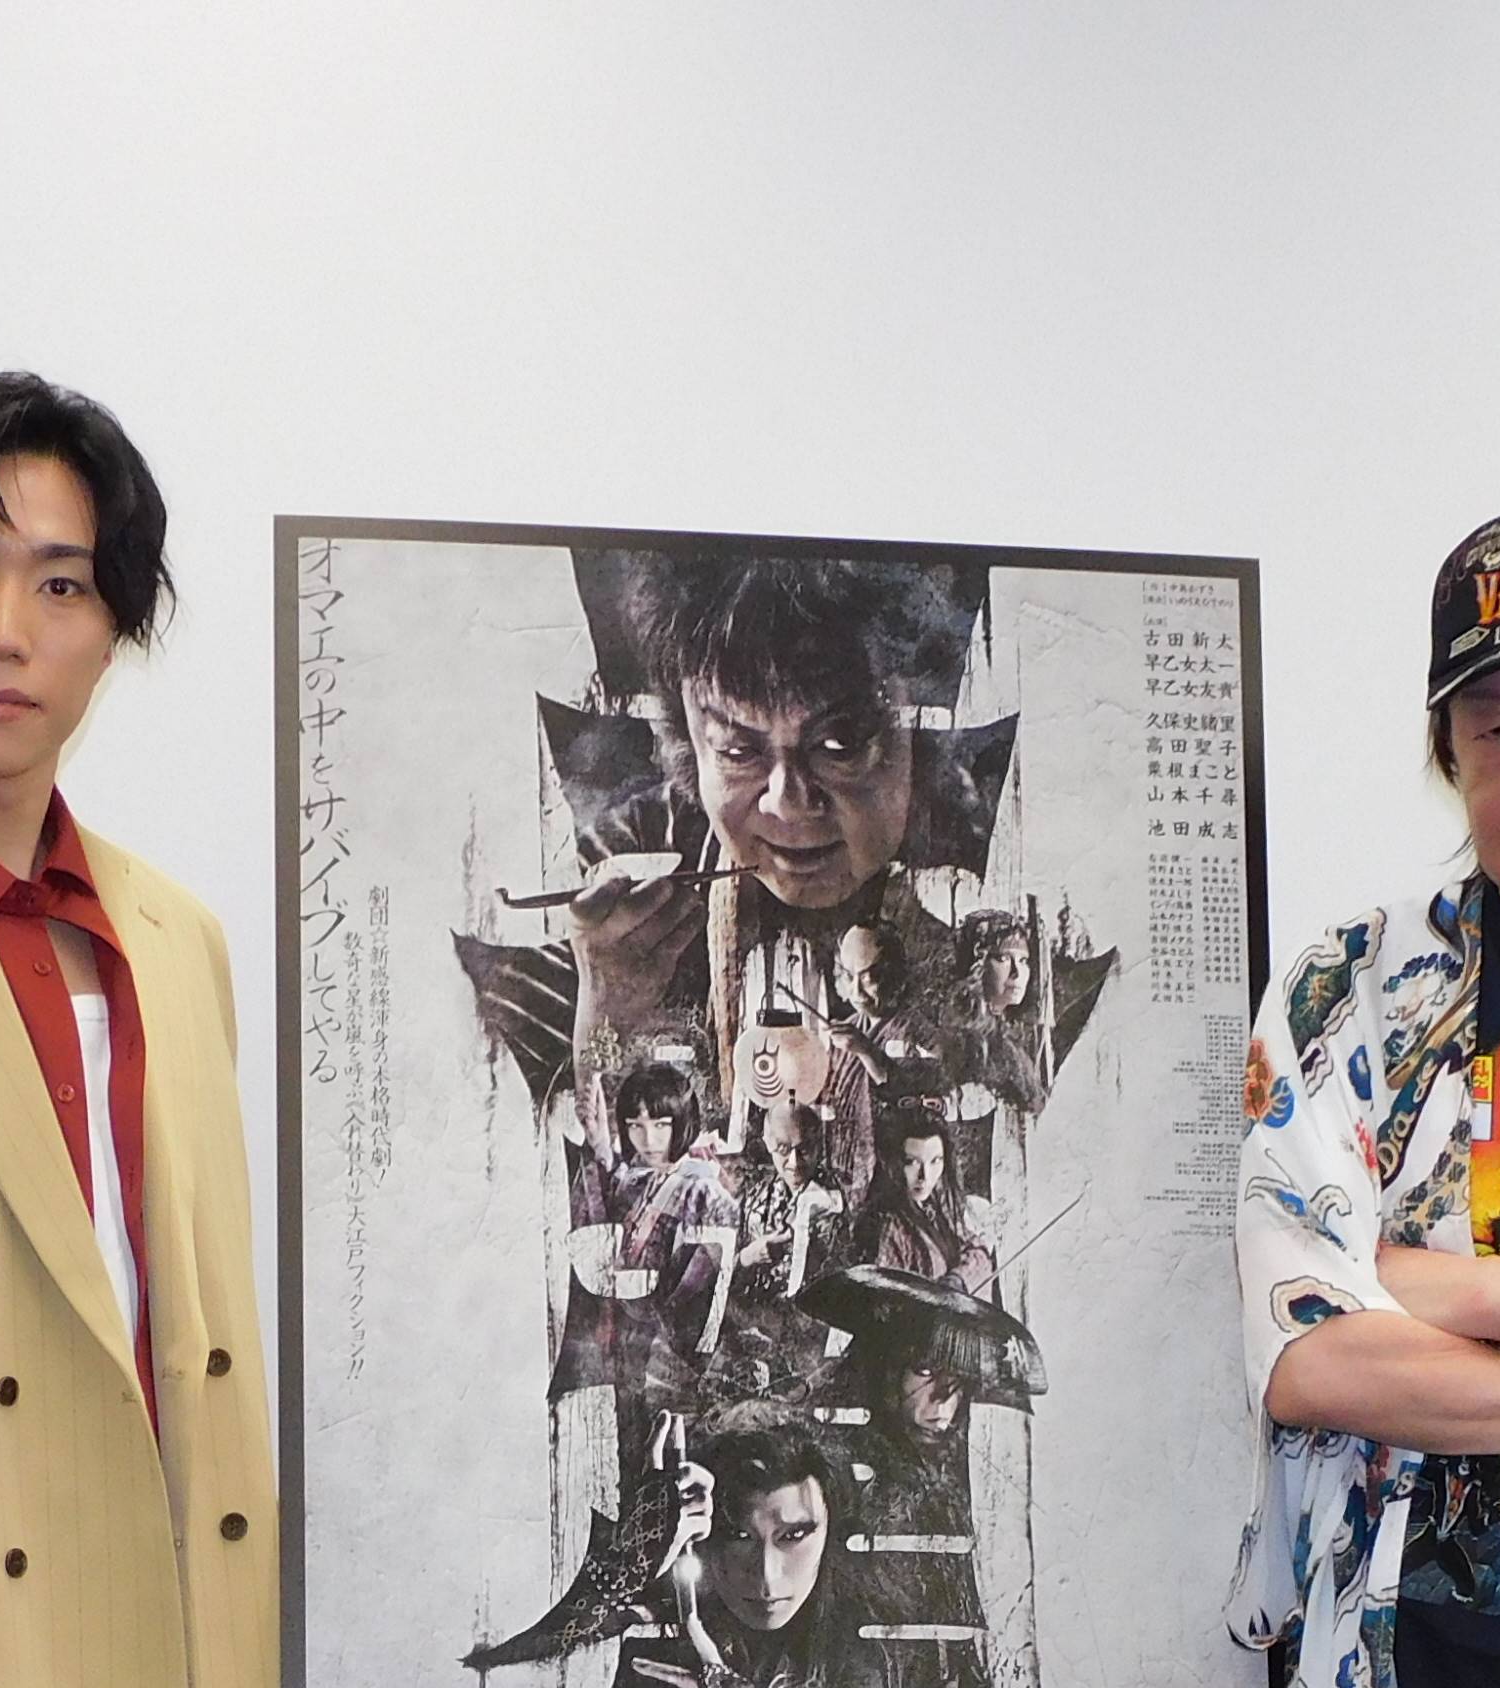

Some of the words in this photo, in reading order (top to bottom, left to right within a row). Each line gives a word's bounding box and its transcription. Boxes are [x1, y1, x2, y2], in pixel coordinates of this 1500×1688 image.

[1143, 630, 1234, 650] 古田新太
[1144, 653, 1235, 674] 早乙女太一
[1145, 678, 1236, 699] 早乙女友貴
[1145, 736, 1237, 756] 高田聖子
[1147, 785, 1238, 807] 山本千尋
[299, 540, 350, 1083] オマエの中をサバイブしてやる
[1148, 818, 1240, 839] 池田成志
